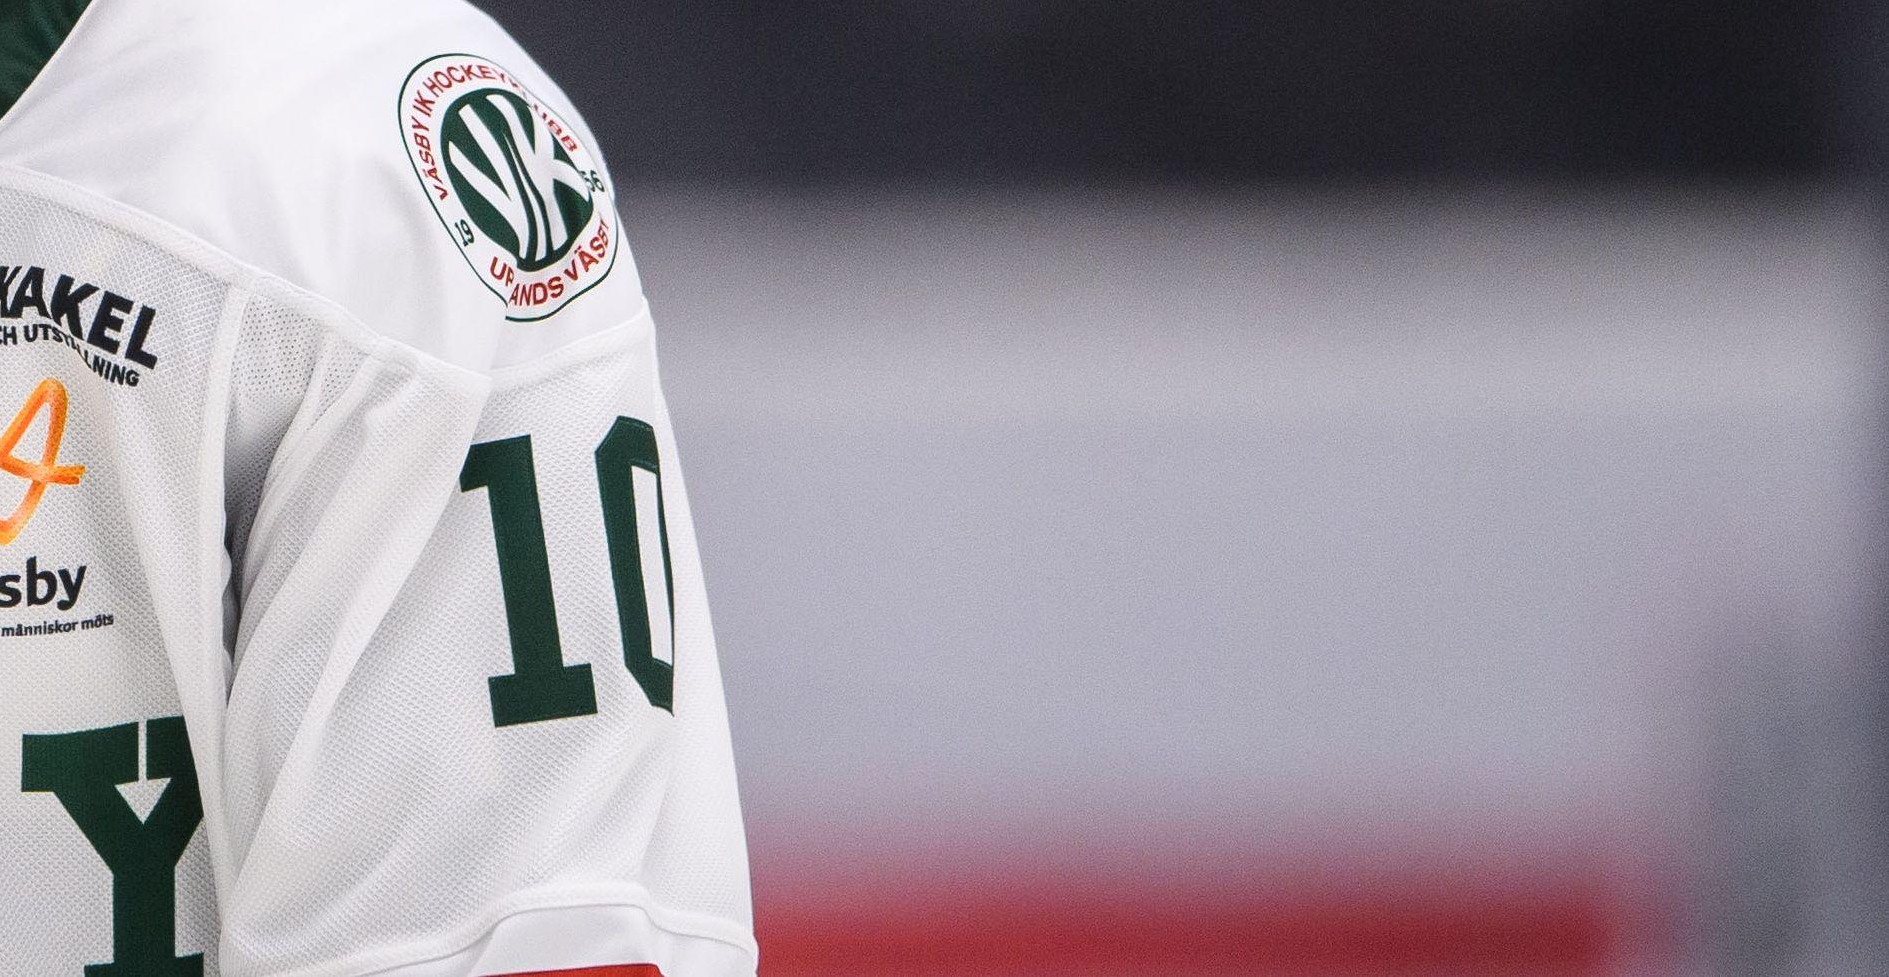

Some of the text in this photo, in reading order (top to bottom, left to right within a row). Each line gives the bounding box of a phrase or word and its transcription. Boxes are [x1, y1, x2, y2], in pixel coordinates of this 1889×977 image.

[412, 90, 436, 118] IK
[411, 115, 449, 201] VÄSBY
[453, 218, 475, 247] 19
[460, 414, 675, 728] 10
[1, 621, 79, 637] människor
